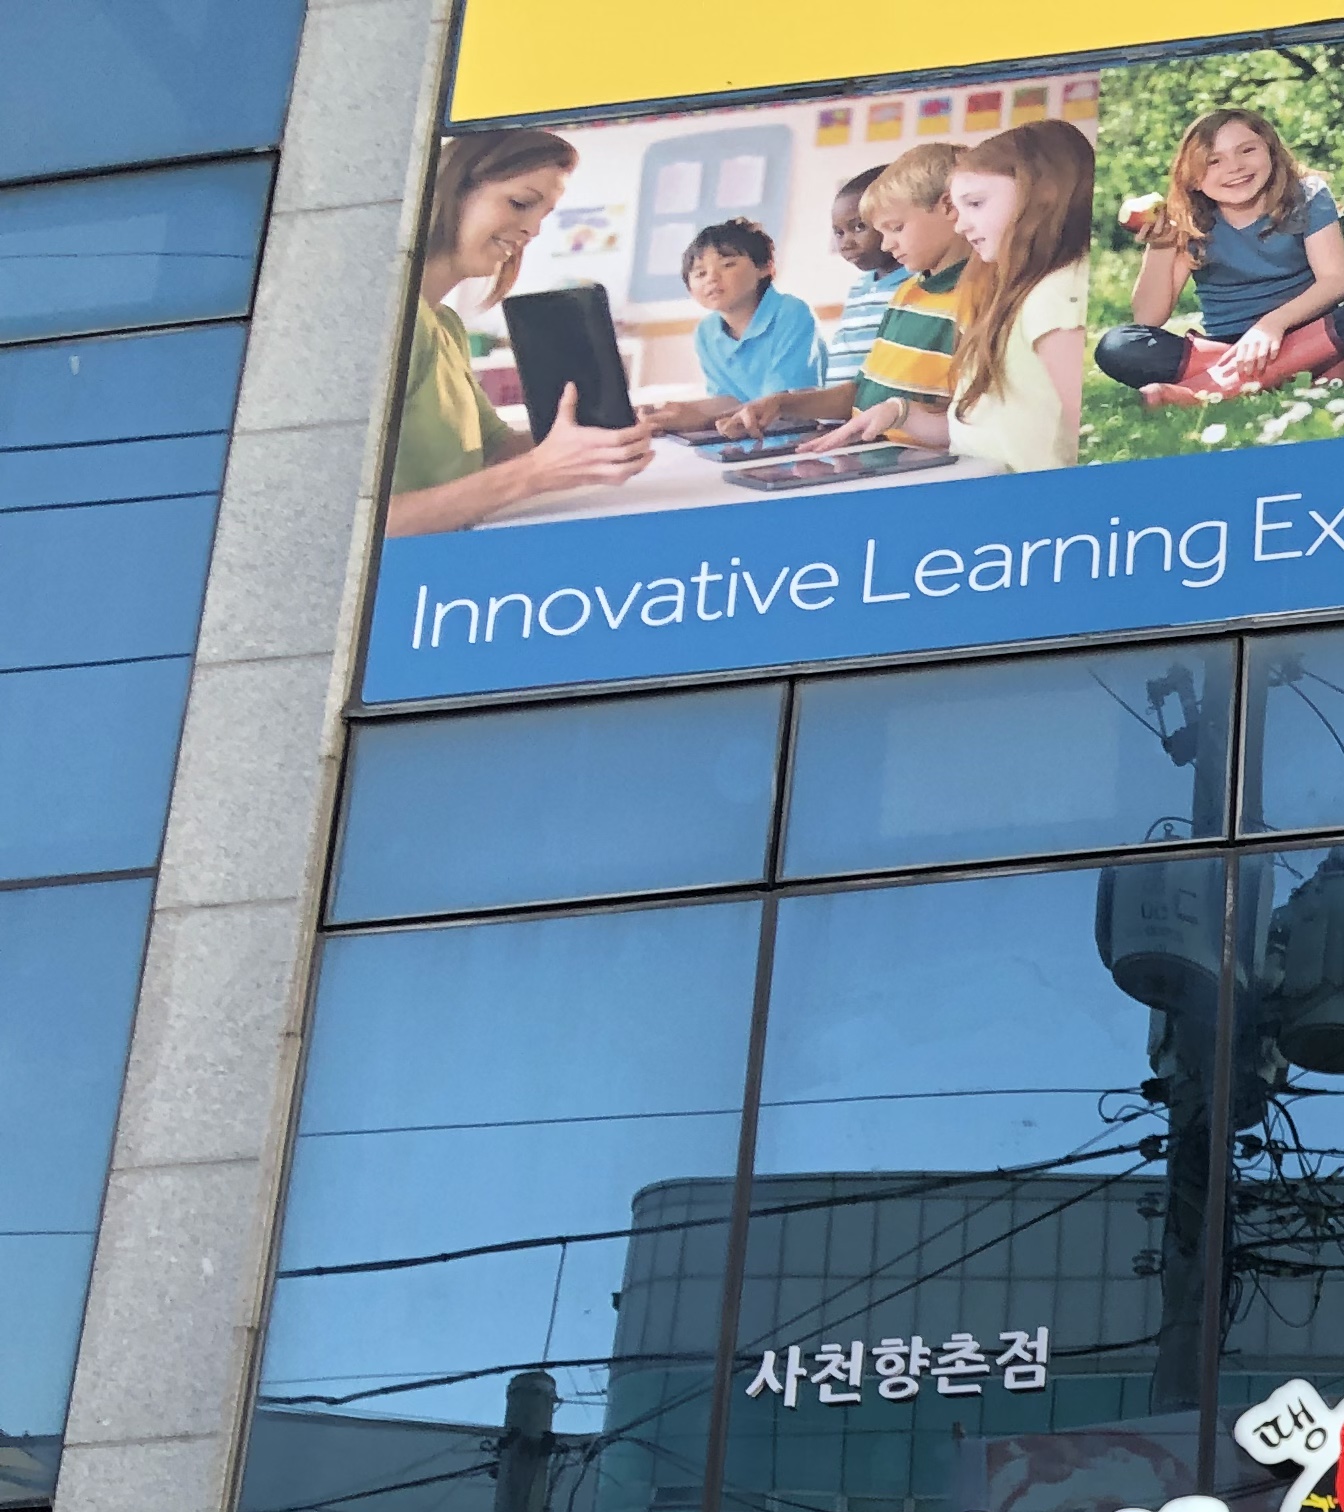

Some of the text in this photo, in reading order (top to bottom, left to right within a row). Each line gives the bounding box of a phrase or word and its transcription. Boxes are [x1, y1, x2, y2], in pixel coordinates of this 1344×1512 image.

[410, 556, 840, 650] Innovative
[861, 514, 1229, 588] Learning
[745, 1326, 1051, 1409] 사천향촌점
